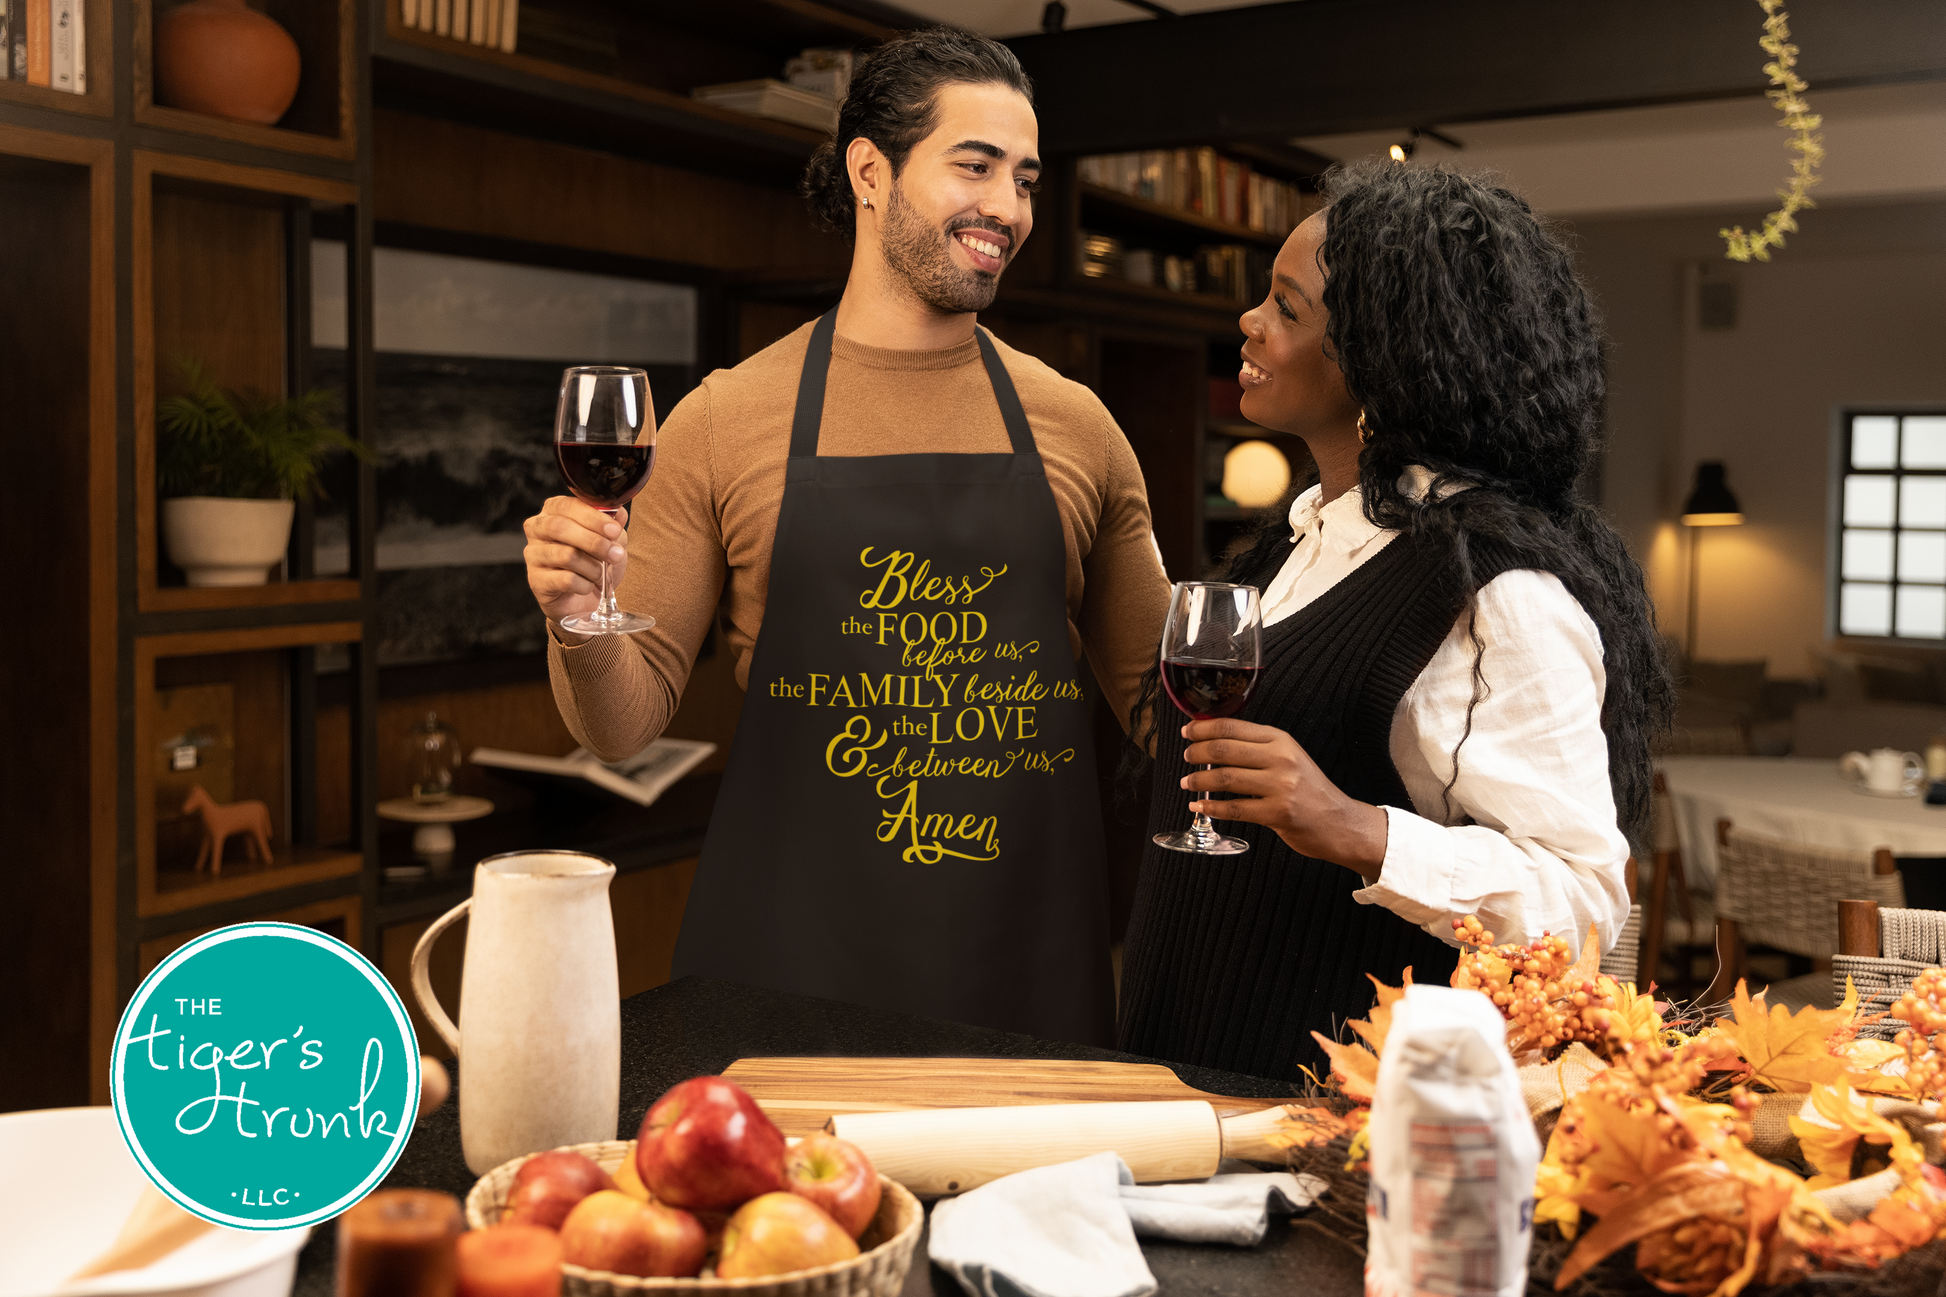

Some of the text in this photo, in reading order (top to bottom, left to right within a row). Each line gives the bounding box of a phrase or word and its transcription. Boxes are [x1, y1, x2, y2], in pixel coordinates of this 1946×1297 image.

[860, 546, 1008, 609] Bless
[841, 611, 988, 646] the FOOD
[902, 637, 1040, 681] before us,
[769, 677, 805, 699] the
[806, 672, 961, 708] FAMILY
[963, 670, 1049, 703] beside
[825, 705, 1039, 778] & the LOVE
[866, 746, 1075, 778] between us,
[876, 774, 1000, 865] Amen
